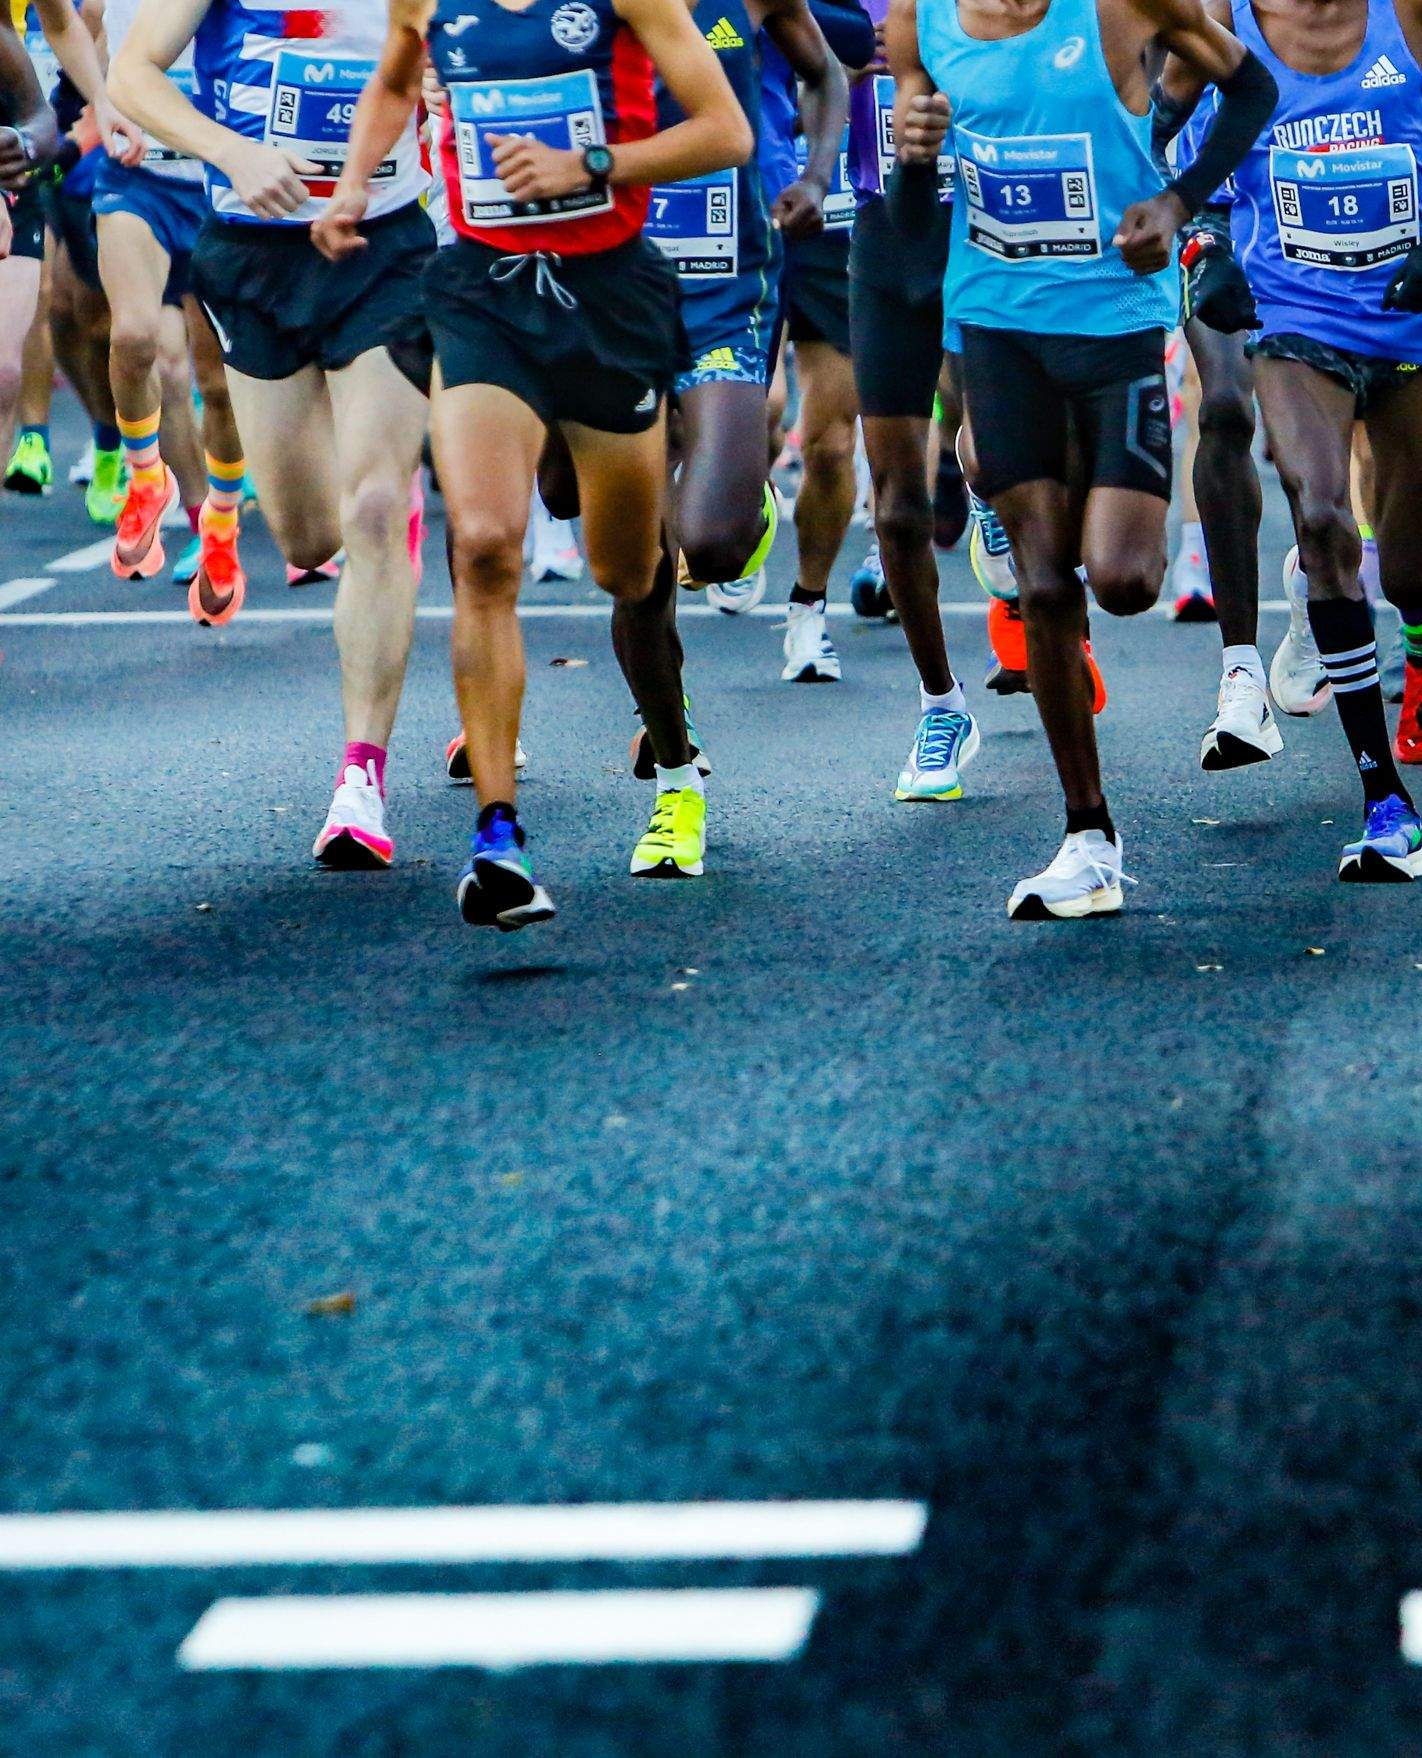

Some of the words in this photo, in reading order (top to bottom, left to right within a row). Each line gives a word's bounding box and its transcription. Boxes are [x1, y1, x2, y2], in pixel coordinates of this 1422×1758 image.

[1361, 73, 1406, 89] adidas
[1331, 160, 1383, 174] Movistar
[1000, 184, 1032, 207] 13
[1328, 195, 1359, 217] 18
[1052, 244, 1092, 252] MADRID
[1333, 239, 1360, 248] Wisley
[1378, 241, 1412, 258] MADRID
[690, 261, 728, 270] MADRID
